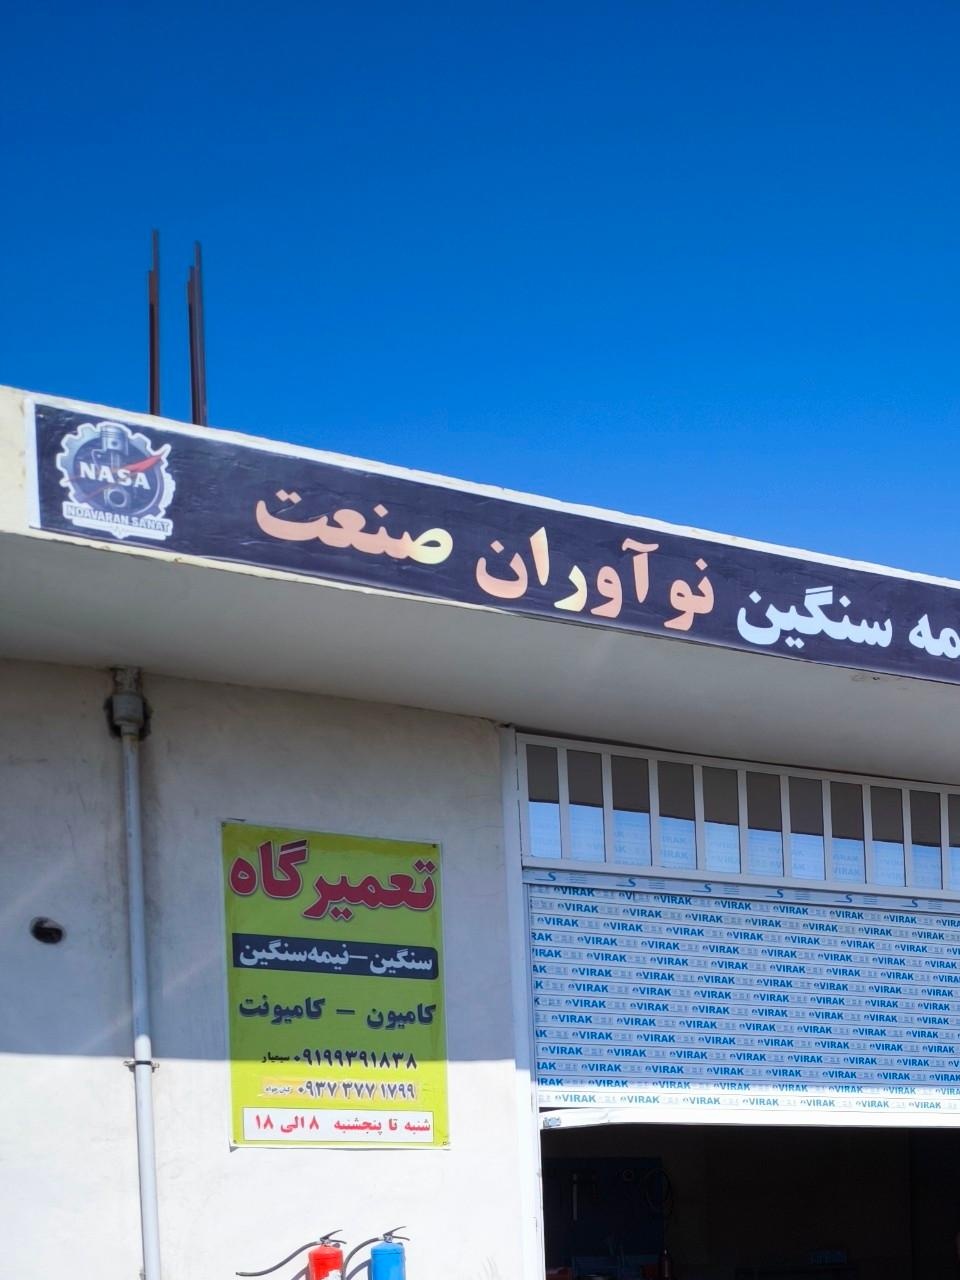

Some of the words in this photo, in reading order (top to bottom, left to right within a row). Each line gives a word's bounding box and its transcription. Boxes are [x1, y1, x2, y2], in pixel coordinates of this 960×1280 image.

[79, 461, 151, 490] NASA
[255, 489, 454, 565] صنعت
[737, 585, 893, 649] سنگین
[564, 903, 598, 913] VIRAK
[629, 908, 662, 918] VIRAK
[691, 913, 723, 923] VIRAK
[751, 918, 781, 927] VIRAK
[808, 922, 837, 931] VIRAK
[864, 927, 892, 936] VIRAK
[917, 931, 944, 940] VIRAK
[720, 900, 751, 910] VIRAK
[779, 905, 808, 914] VIRAK
[835, 910, 863, 919] VIRAK
[889, 914, 917, 923] VIRAK
[544, 917, 578, 926] VIRAK
[610, 922, 643, 931] VIRAK
[672, 927, 704, 936] VIRAK
[732, 931, 763, 940] VIRAK
[790, 936, 820, 945] VIRAK
[846, 940, 874, 949] VIRAK
[900, 944, 927, 953] VIRAK
[584, 936, 617, 945] VIRAK
[647, 940, 680, 950] VIRAK
[708, 945, 739, 954] VIRAK
[767, 949, 797, 958] VIRAK
[823, 953, 852, 962] VIRAK
[877, 957, 905, 966] VIRAK
[930, 960, 957, 969] VIRAK
[593, 952, 626, 962] VIRAK
[656, 957, 688, 966] VIRAK
[717, 961, 748, 970] VIRAK
[775, 964, 805, 973] VIRAK
[831, 968, 860, 977] VIRAK
[886, 971, 914, 980] VIRAK
[578, 967, 612, 977] VIRAK
[642, 971, 674, 980] VIRAK
[703, 975, 735, 984] VIRAK
[762, 978, 792, 987] VIRAK
[819, 982, 848, 991] VIRAK
[874, 985, 902, 994] VIRAK
[926, 988, 953, 997] VIRAK
[575, 983, 608, 992] VIRAK
[638, 987, 671, 996] VIRAK
[700, 990, 731, 999] VIRAK
[759, 993, 789, 1002] VIRAK
[816, 996, 845, 1005] VIRAK
[870, 999, 898, 1008] VIRAK
[923, 1002, 950, 1011] VIRAK
[238, 995, 326, 1025] کامیونت
[366, 1003, 436, 1029] کامیون
[572, 999, 606, 1008] VIRAK
[636, 1002, 669, 1011] VIRAK
[698, 1005, 729, 1014] VIRAK
[757, 1008, 787, 1017] VIRAK
[814, 1011, 843, 1020] VIRAK
[869, 1014, 897, 1023] VIRAK
[922, 1016, 949, 1025] VIRAK
[558, 1014, 592, 1023] VIRAK
[623, 1017, 656, 1026] VIRAK
[685, 1020, 717, 1029] VIRAK
[745, 1023, 775, 1032] VIRAK
[803, 1025, 832, 1034] VIRAK
[858, 1028, 886, 1037] VIRAK
[911, 1030, 938, 1039] VIRAK
[578, 1031, 612, 1040] VIRAK
[643, 1034, 675, 1043] VIRAK
[704, 1036, 735, 1045] VIRAK
[763, 1038, 793, 1047] VIRAK
[820, 1041, 849, 1049] VIRAK
[875, 1043, 903, 1052] VIRAK
[927, 1045, 954, 1054] VIRAK
[548, 1046, 582, 1055] VIRAK
[613, 1048, 646, 1057] VIRAK
[675, 1050, 707, 1059] VIRAK
[735, 1052, 766, 1061] VIRAK
[793, 1055, 823, 1063] VIRAK
[849, 1057, 877, 1065] VIRAK
[902, 1058, 929, 1067] VIRAK
[587, 1063, 621, 1072] VIRAK
[651, 1065, 683, 1074] VIRAK
[712, 1067, 743, 1076] VIRAK
[771, 1069, 801, 1077] VIRAK
[828, 1071, 857, 1079] VIRAK
[882, 1072, 910, 1081] VIRAK
[934, 1074, 960, 1082] VIRAK
[562, 1094, 596, 1103] VIRAK
[627, 1095, 659, 1104] VIRAK
[689, 1097, 720, 1105] VIRAK
[748, 1098, 779, 1106] VIRAK
[806, 1099, 835, 1107] VIRAK
[861, 1100, 889, 1108] VIRAK
[914, 1101, 941, 1109] VIRAK
[255, 1114, 274, 1129] ۱۸
[280, 1115, 305, 1133] الی
[309, 1116, 320, 1131] ۸
[334, 1117, 382, 1135] پنجشنبه
[388, 1118, 398, 1131] تا
[404, 1118, 431, 1135] شنبه
